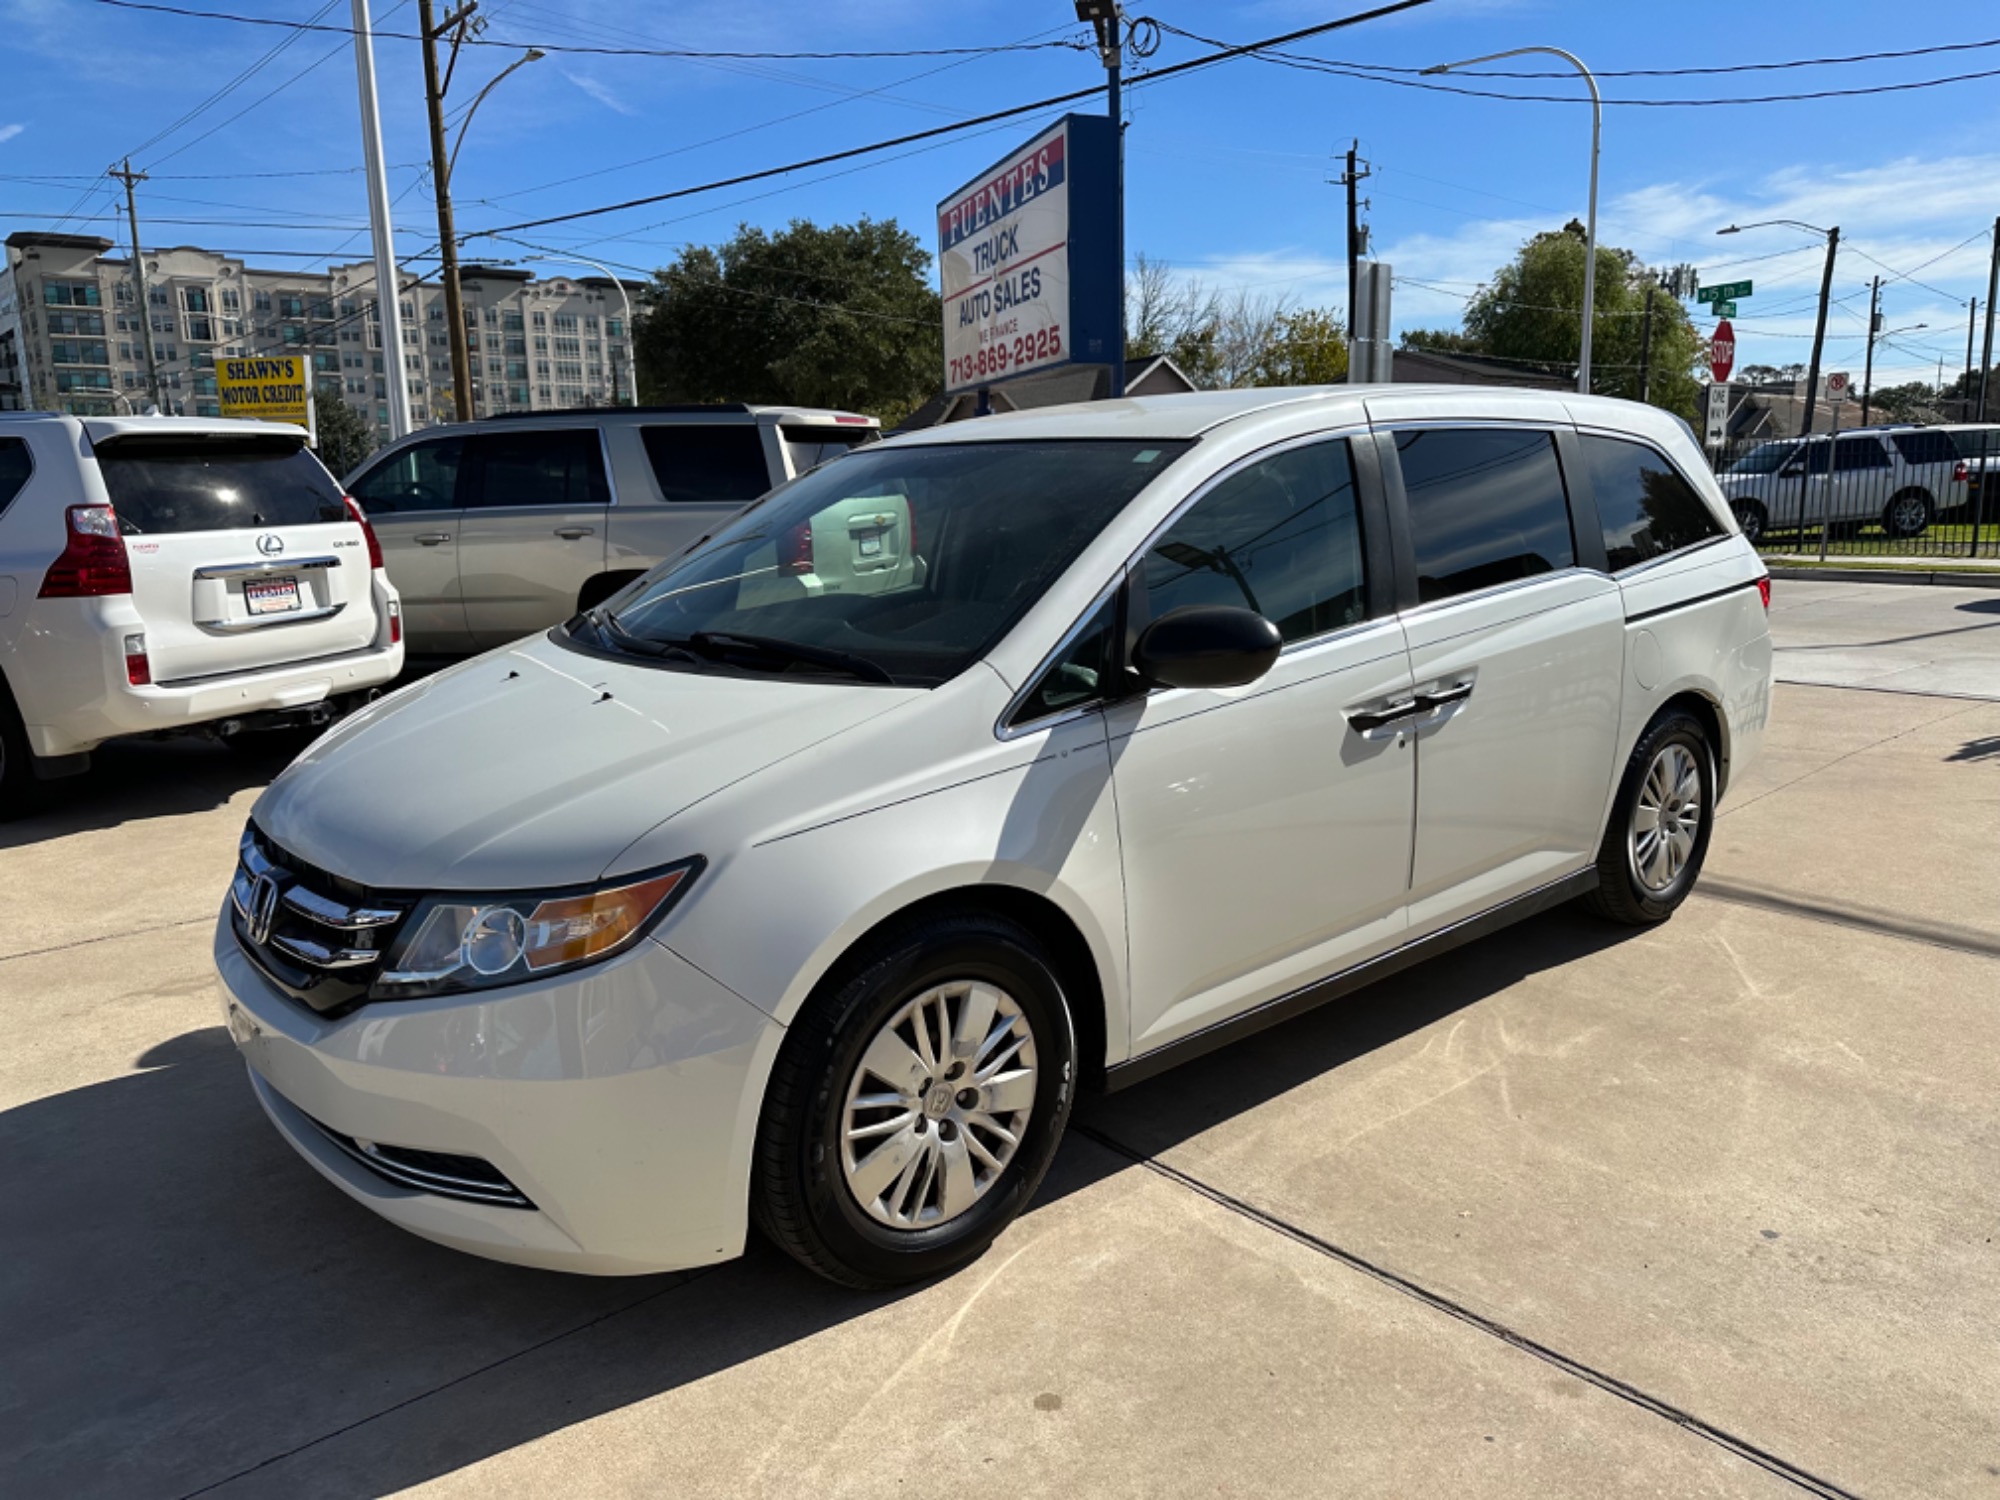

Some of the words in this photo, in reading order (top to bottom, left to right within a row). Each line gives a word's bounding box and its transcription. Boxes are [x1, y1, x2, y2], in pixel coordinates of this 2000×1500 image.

[950, 149, 1049, 244] FUENTES
[973, 224, 1019, 274] TRUCK
[959, 290, 991, 328] AUTO
[993, 266, 1042, 313] SALES
[950, 325, 1060, 383] 713-869-2925
[1711, 340, 1733, 364] STOP
[226, 360, 294, 380] SHAWN'S
[221, 386, 261, 405] MOTOR
[263, 384, 303, 403] CREDIT
[1712, 388, 1726, 404] ONE
[1710, 407, 1726, 421] WAY
